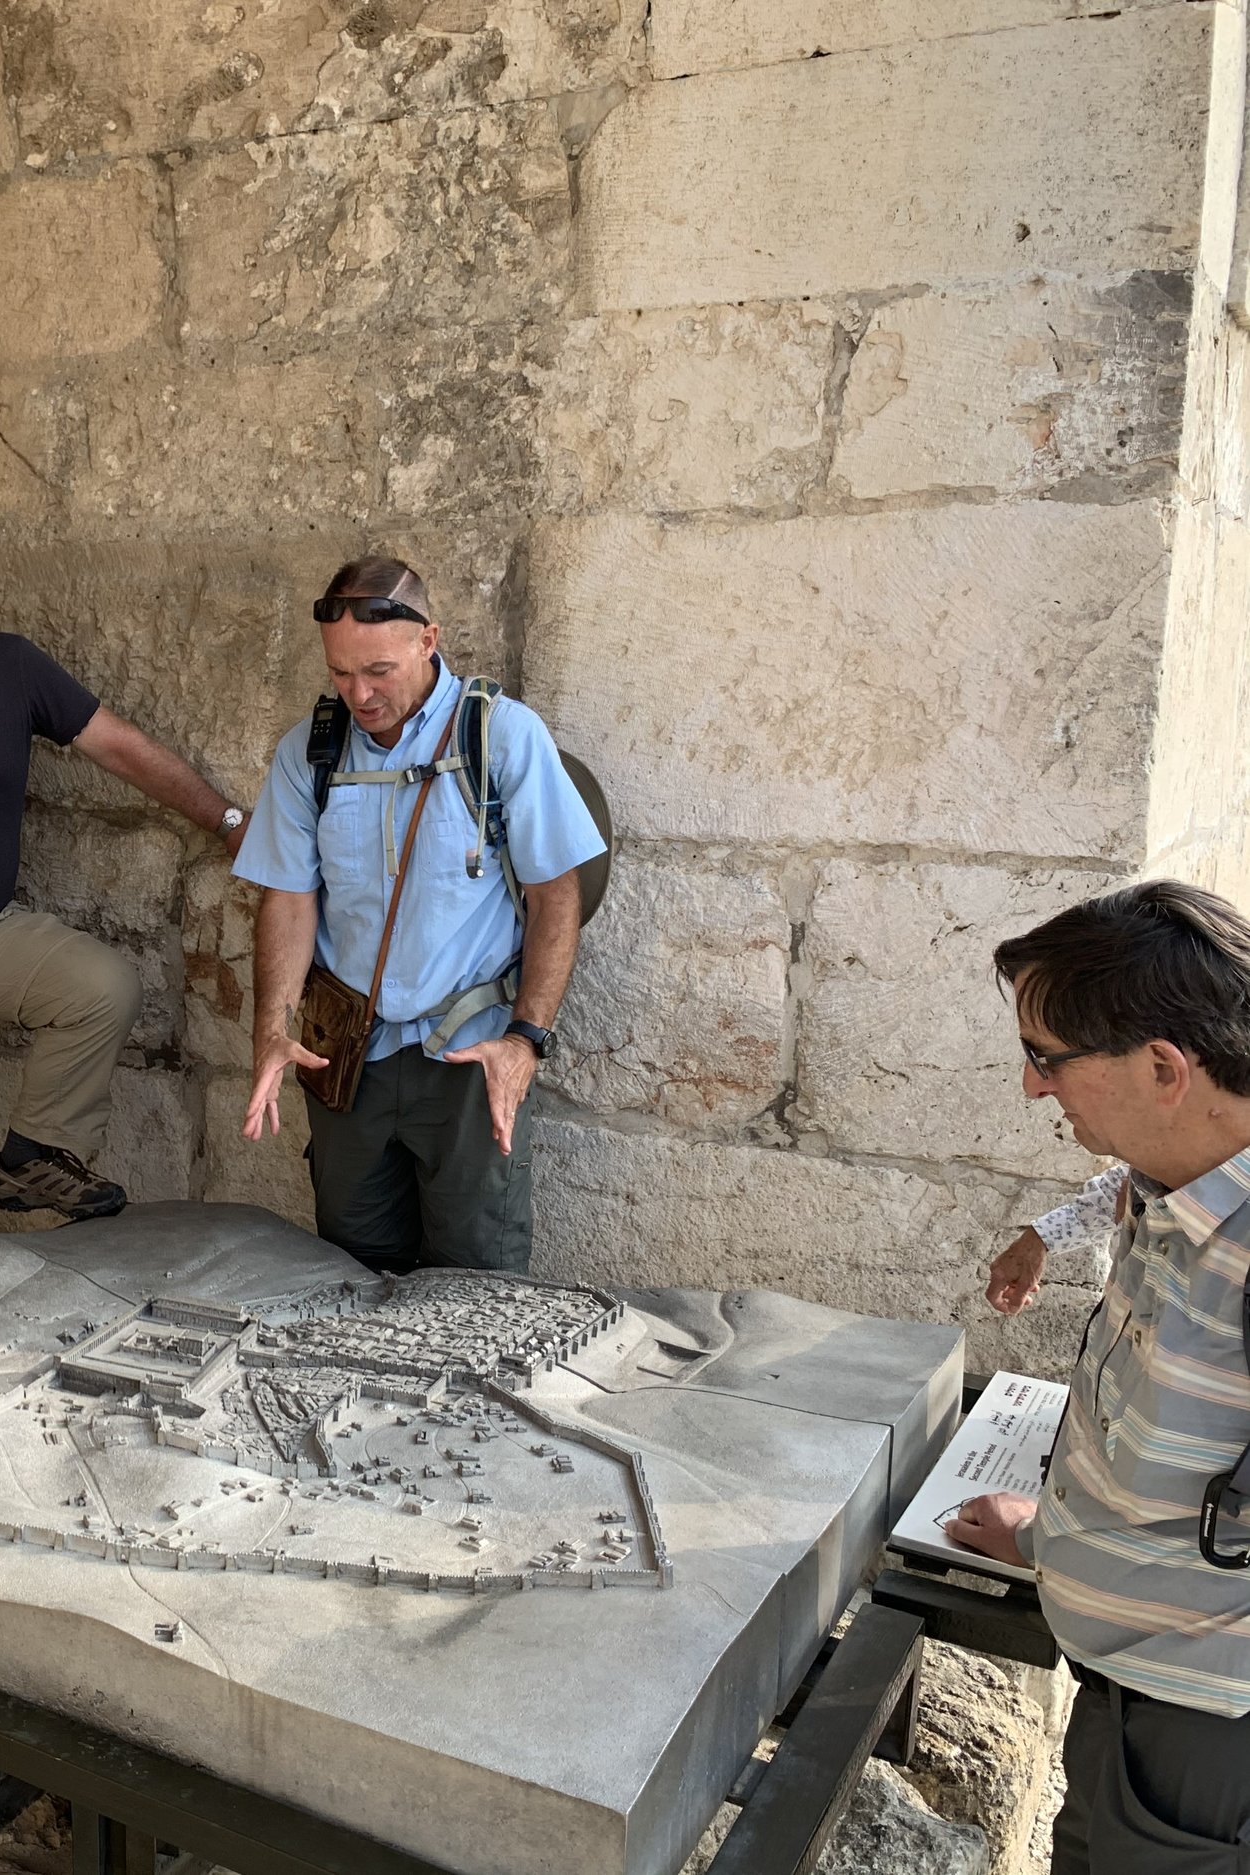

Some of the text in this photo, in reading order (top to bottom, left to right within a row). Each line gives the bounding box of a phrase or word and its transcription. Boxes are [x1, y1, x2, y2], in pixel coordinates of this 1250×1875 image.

[955, 1460, 971, 1478] Jerusalem
[969, 1443, 997, 1481] Second Temple Period
